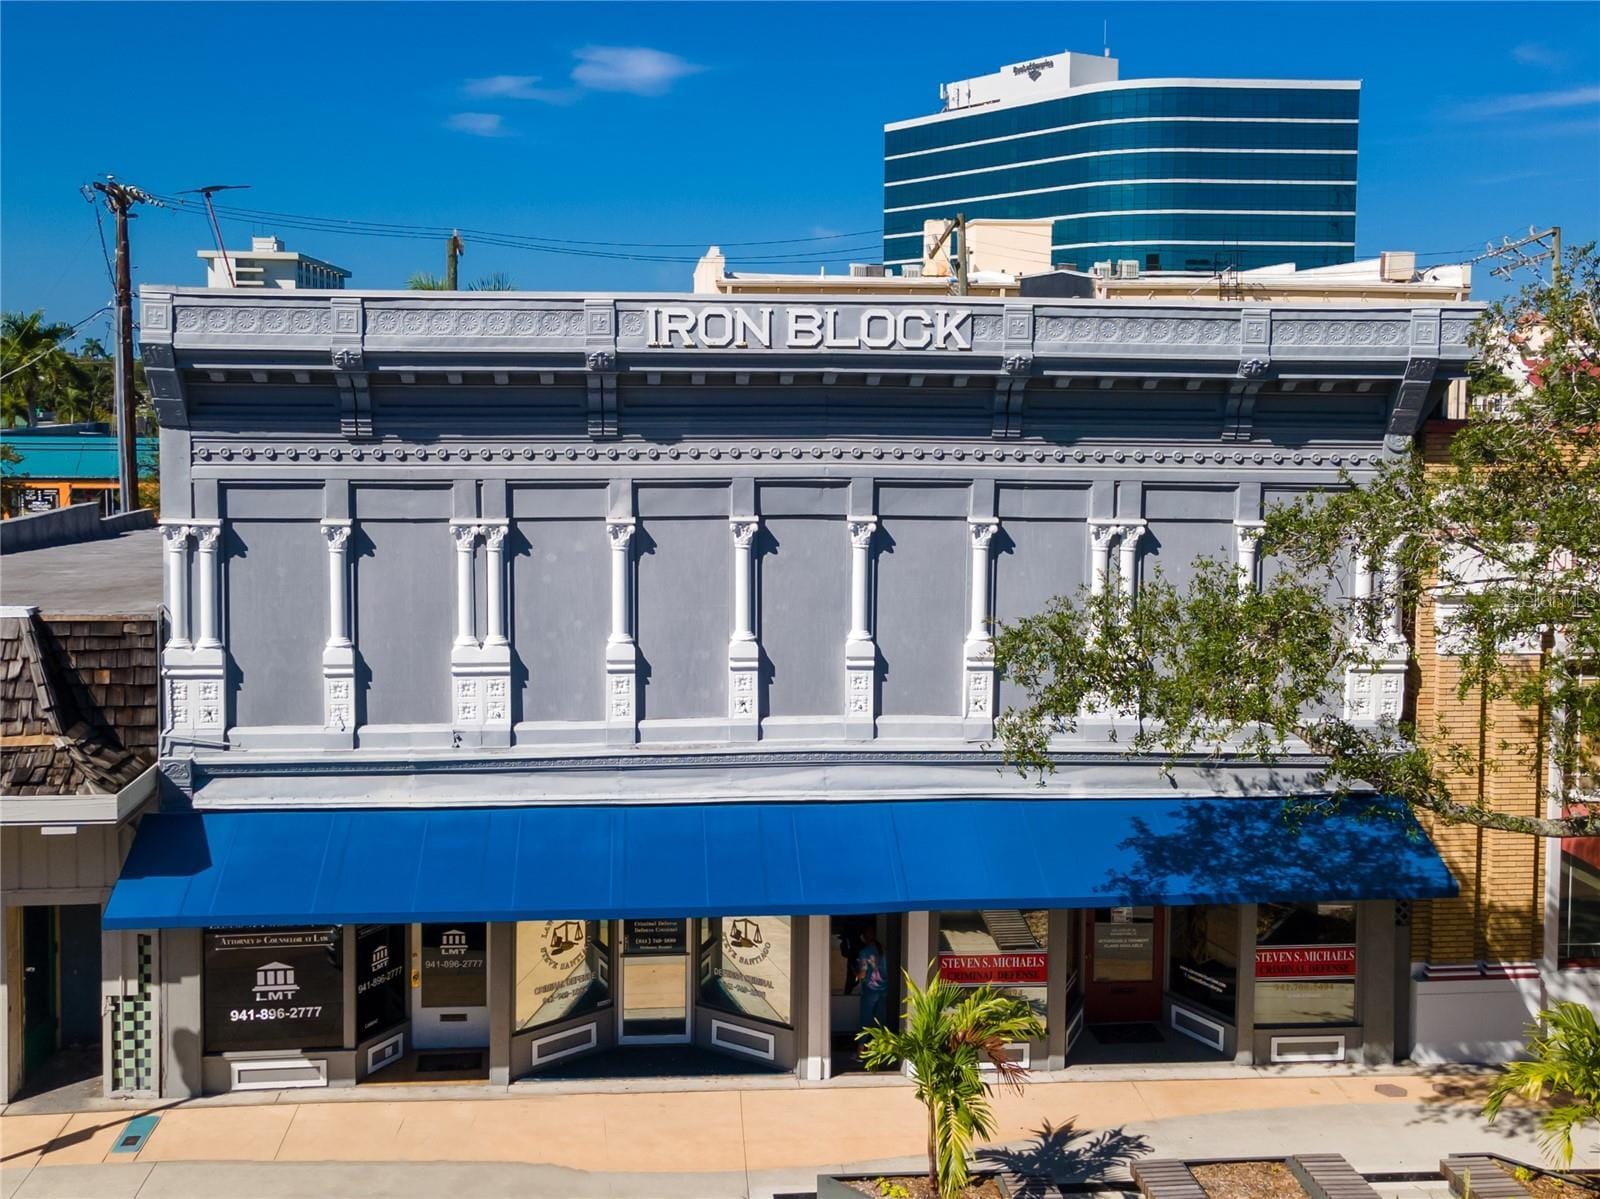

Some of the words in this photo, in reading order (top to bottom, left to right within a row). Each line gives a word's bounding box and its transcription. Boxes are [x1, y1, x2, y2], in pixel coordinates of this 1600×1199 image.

[645, 307, 774, 349] IRON
[785, 307, 972, 351] BLOCK
[440, 948, 467, 956] LMT
[739, 942, 772, 966] SANTIAGO
[1255, 951, 1293, 963] STEVEN
[1294, 951, 1303, 962] S.
[1304, 949, 1355, 962] MICHAELS
[371, 960, 389, 973] LMT
[941, 957, 980, 969] STEVEN
[982, 957, 992, 969] S.
[992, 956, 1045, 968] MICHAELS
[947, 971, 993, 981] CRIMINAL
[997, 970, 1038, 980] DEFENSE
[255, 990, 297, 1002] LMT
[230, 1006, 323, 1022] 941-896-2777
